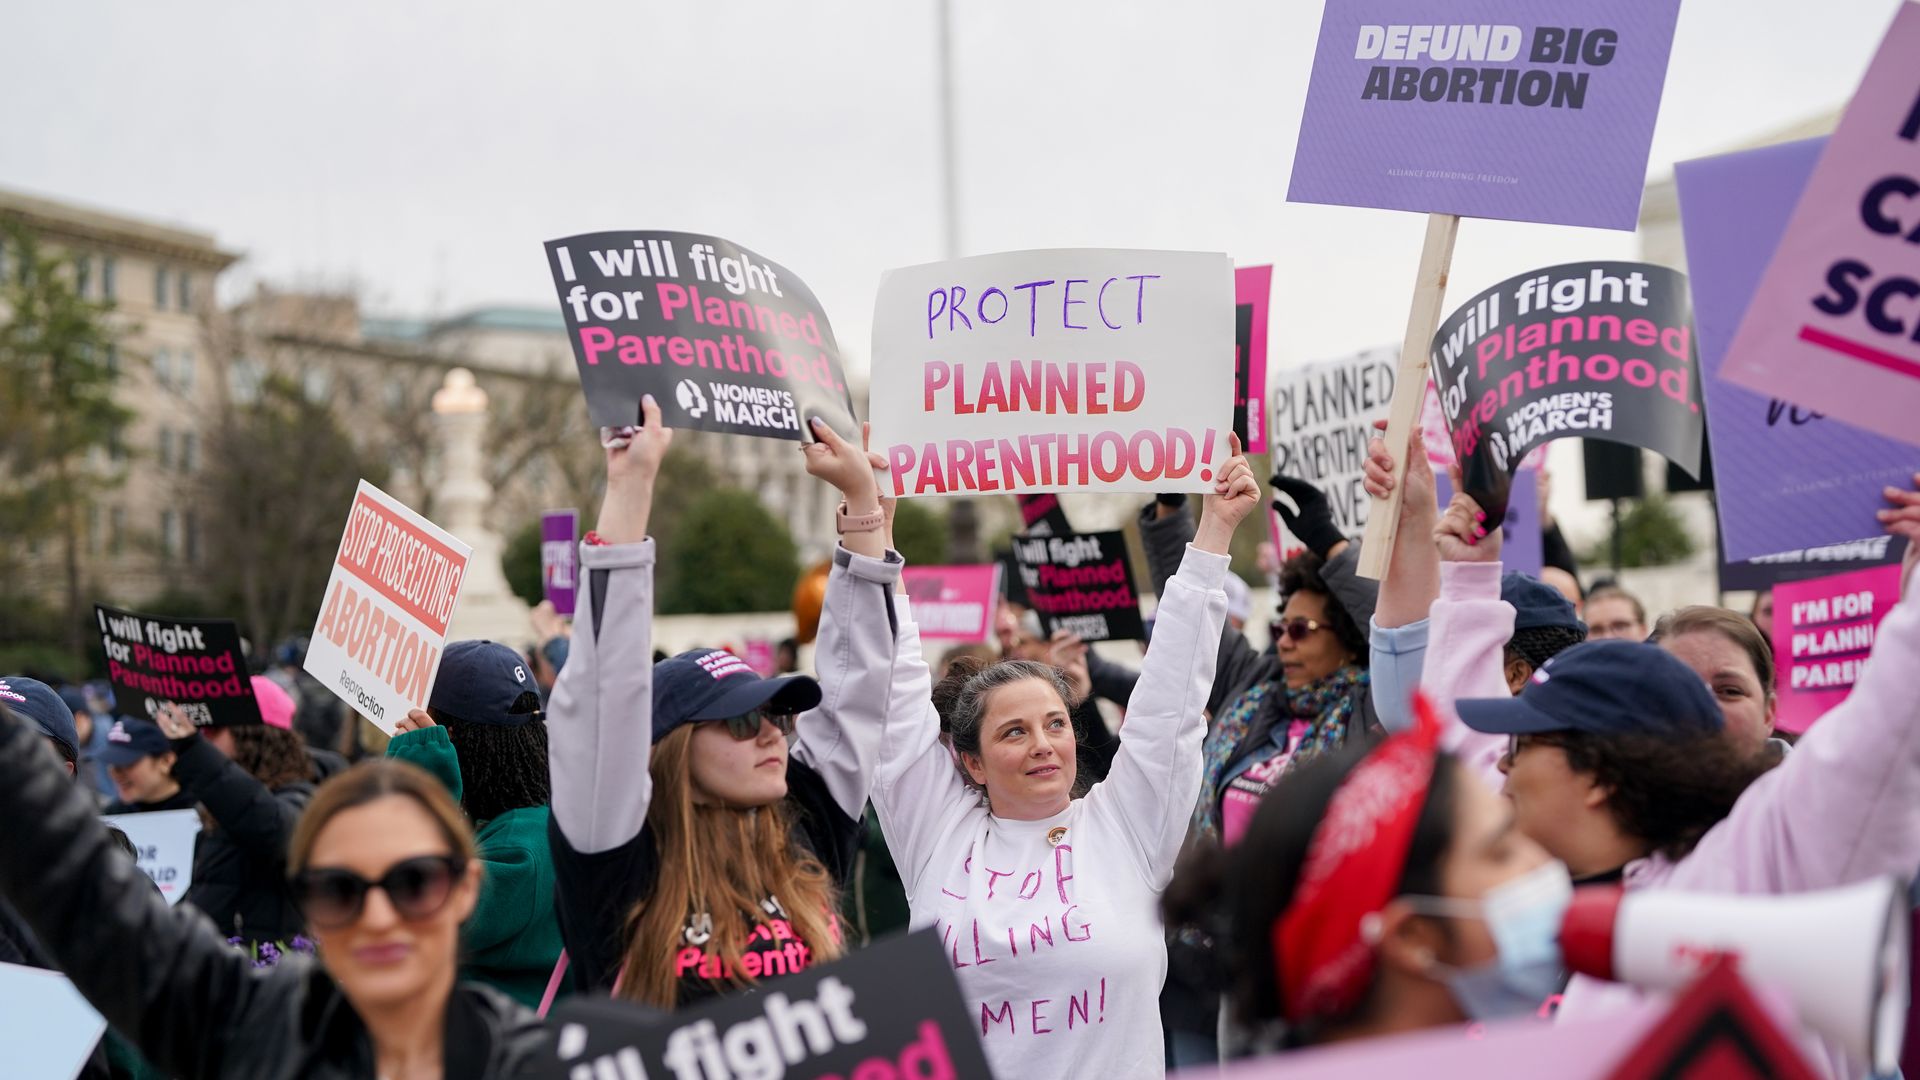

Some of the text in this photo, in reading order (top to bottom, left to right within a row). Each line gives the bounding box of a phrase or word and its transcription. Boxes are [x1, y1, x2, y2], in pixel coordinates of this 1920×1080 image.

[1354, 25, 1619, 66] DEFUND BIG
[1360, 66, 1590, 110] ABORTION
[1387, 168, 1520, 185] ALLIANCE DEFENDING FREEDOM
[556, 239, 783, 298] I will fight
[566, 282, 822, 347] for Planned
[927, 275, 1161, 339] PROTECT
[1432, 269, 1649, 390] I will fight
[578, 326, 844, 392] Parenthood.
[1475, 314, 1690, 381] Planned
[708, 382, 795, 408] WOMEN'S
[923, 360, 1146, 415] PLANNED
[1276, 363, 1395, 435] PLANNED
[1506, 391, 1613, 432] WOMEN'S
[713, 400, 800, 431] MARCH
[1508, 407, 1613, 458] MARCH
[887, 427, 1217, 497] PARENTHOOD!
[343, 502, 384, 572] STOP
[378, 519, 463, 625] PROSECUTING
[1039, 558, 1126, 588] Planned
[1048, 535, 1103, 567] fight
[97, 608, 206, 654] I will fight
[1791, 591, 1875, 625] I'M FOR
[103, 634, 236, 675] for Planned
[318, 579, 438, 707] ABORTION
[1791, 624, 1873, 657] PLANN
[109, 658, 251, 699] Parenthood.
[338, 669, 385, 720] Reproaction
[661, 976, 868, 1080] fight
[981, 977, 1106, 1037] MEN!
